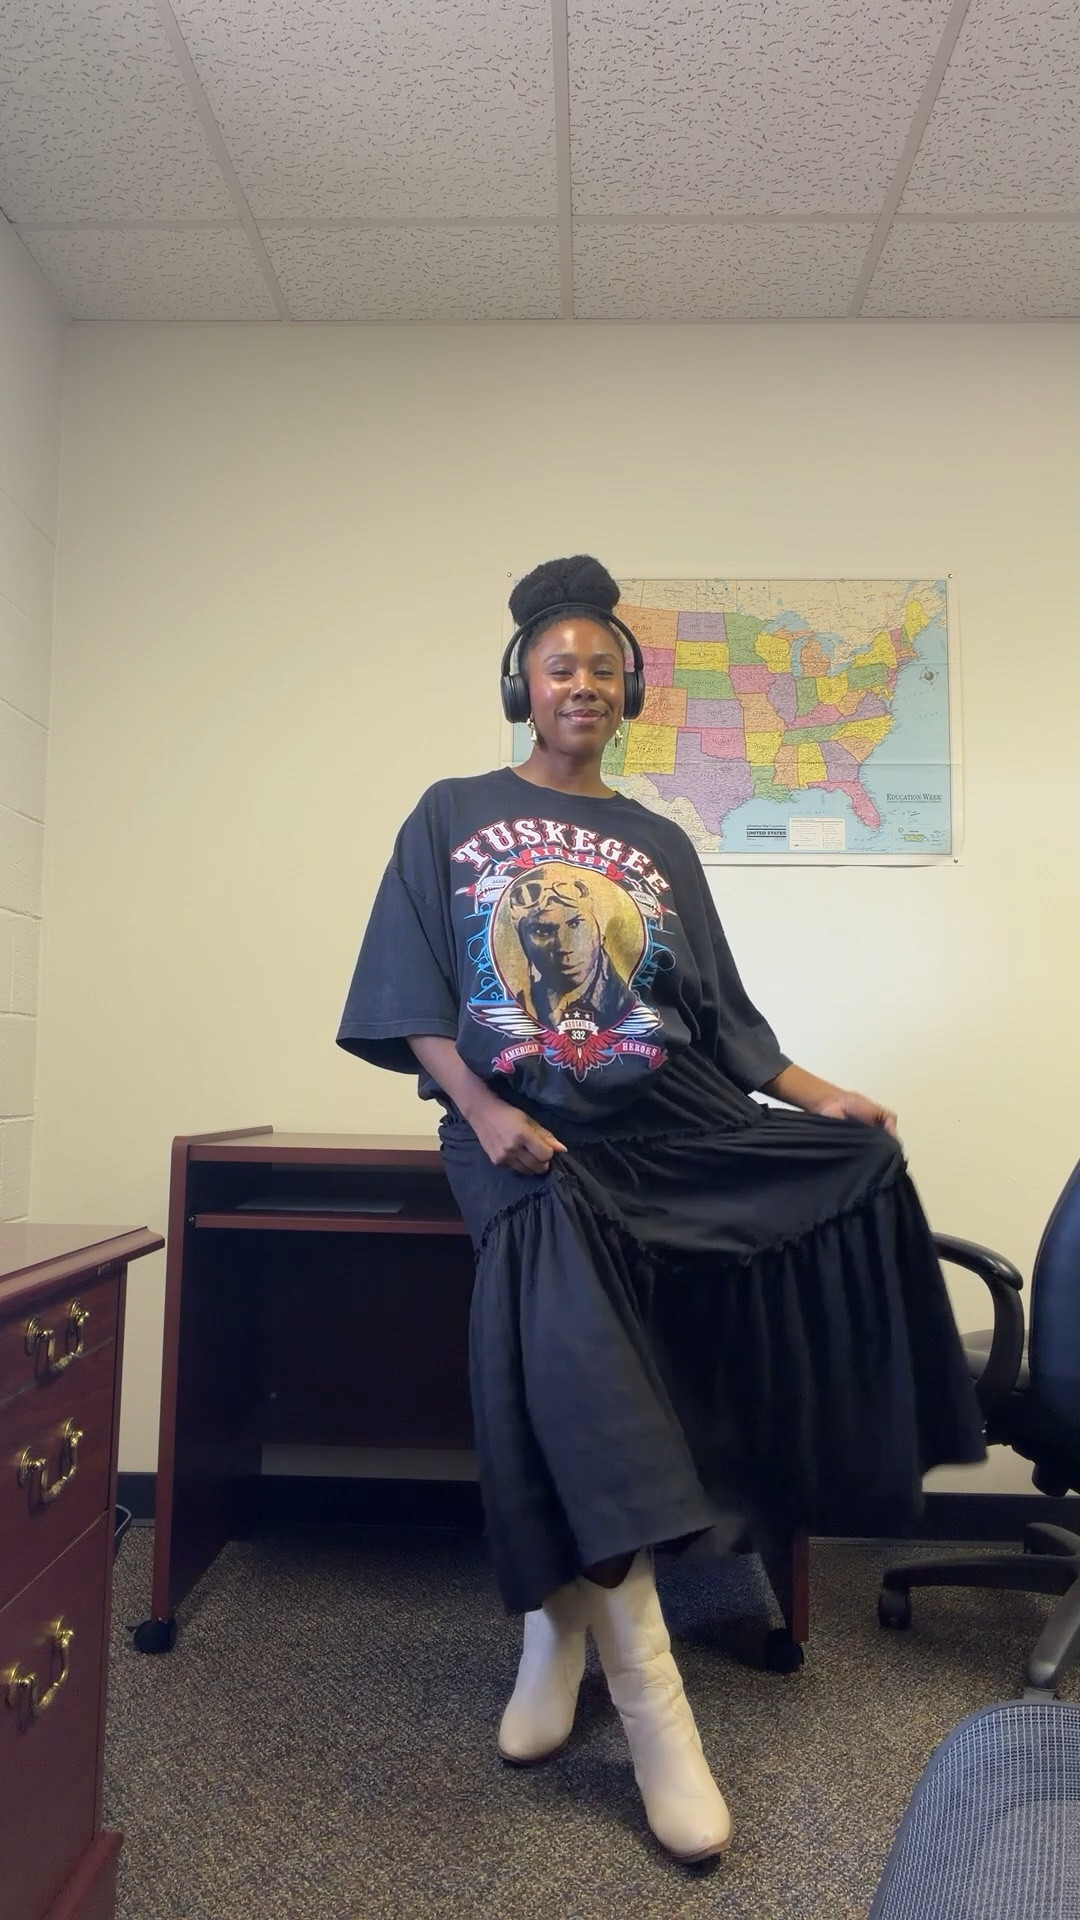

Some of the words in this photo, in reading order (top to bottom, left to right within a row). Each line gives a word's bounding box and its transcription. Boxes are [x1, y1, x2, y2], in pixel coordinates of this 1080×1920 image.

[886, 793, 922, 801] EDUCATION
[922, 793, 942, 801] WEEK
[453, 818, 670, 894] TUSKEGEE
[531, 847, 613, 868] AIRMEN
[571, 1030, 586, 1040] 332
[504, 1043, 539, 1060] AMERICAN
[622, 1042, 657, 1057] HEROES
